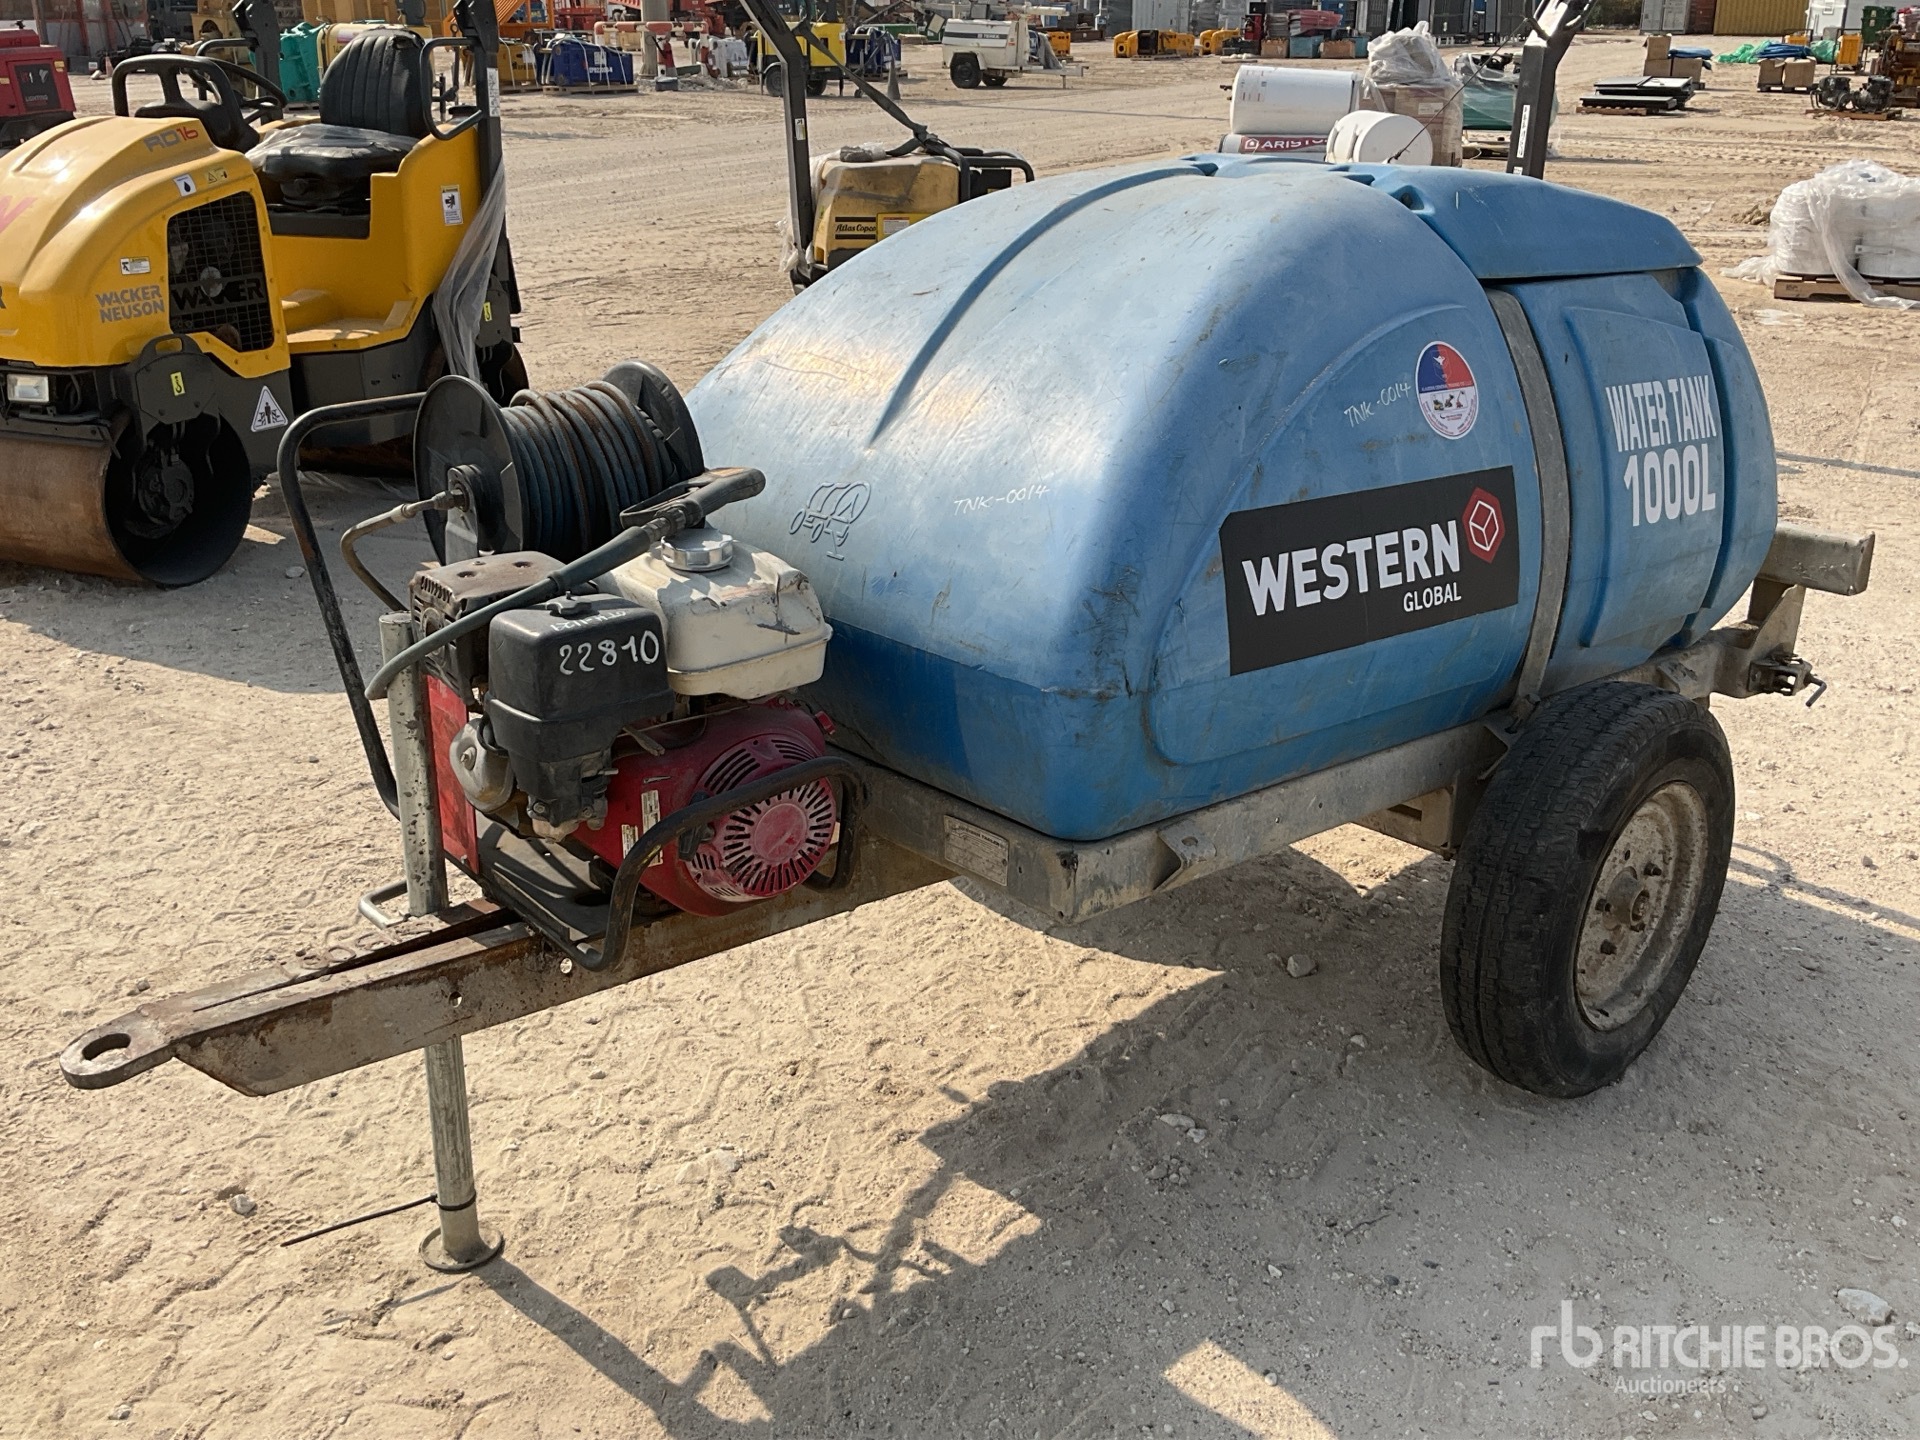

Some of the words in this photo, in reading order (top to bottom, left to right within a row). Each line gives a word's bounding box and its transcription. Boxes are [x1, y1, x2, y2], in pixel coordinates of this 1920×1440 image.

[836, 223, 856, 232] Atlas
[856, 223, 876, 233] Copco
[95, 284, 162, 308] WACKER
[99, 299, 165, 323] NEUSON
[1605, 380, 1671, 453] WATER
[1667, 374, 1717, 443] TANK
[1623, 443, 1716, 527] 1000L
[1241, 519, 1460, 616] WESTERN
[1403, 582, 1462, 612] GLOBAL
[559, 629, 660, 675] 22810
